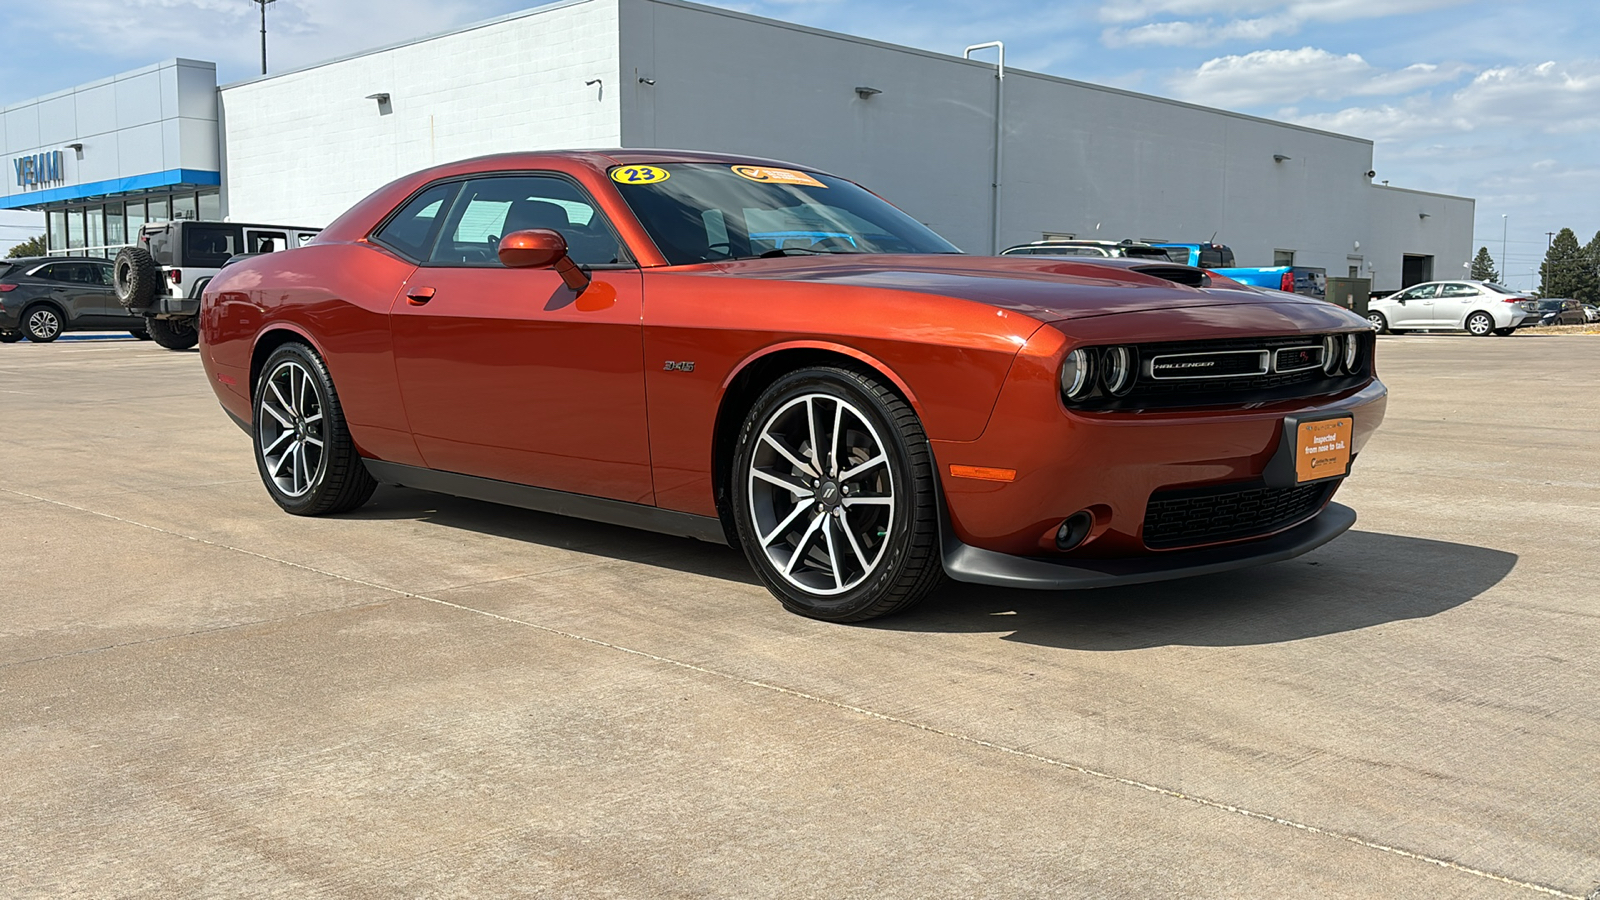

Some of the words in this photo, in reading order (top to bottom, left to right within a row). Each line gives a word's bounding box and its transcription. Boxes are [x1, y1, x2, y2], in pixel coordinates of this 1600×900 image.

[624, 168, 655, 182] 23
[663, 360, 695, 371] 345
[1314, 433, 1336, 444] Inspected
[1305, 446, 1318, 454] from
